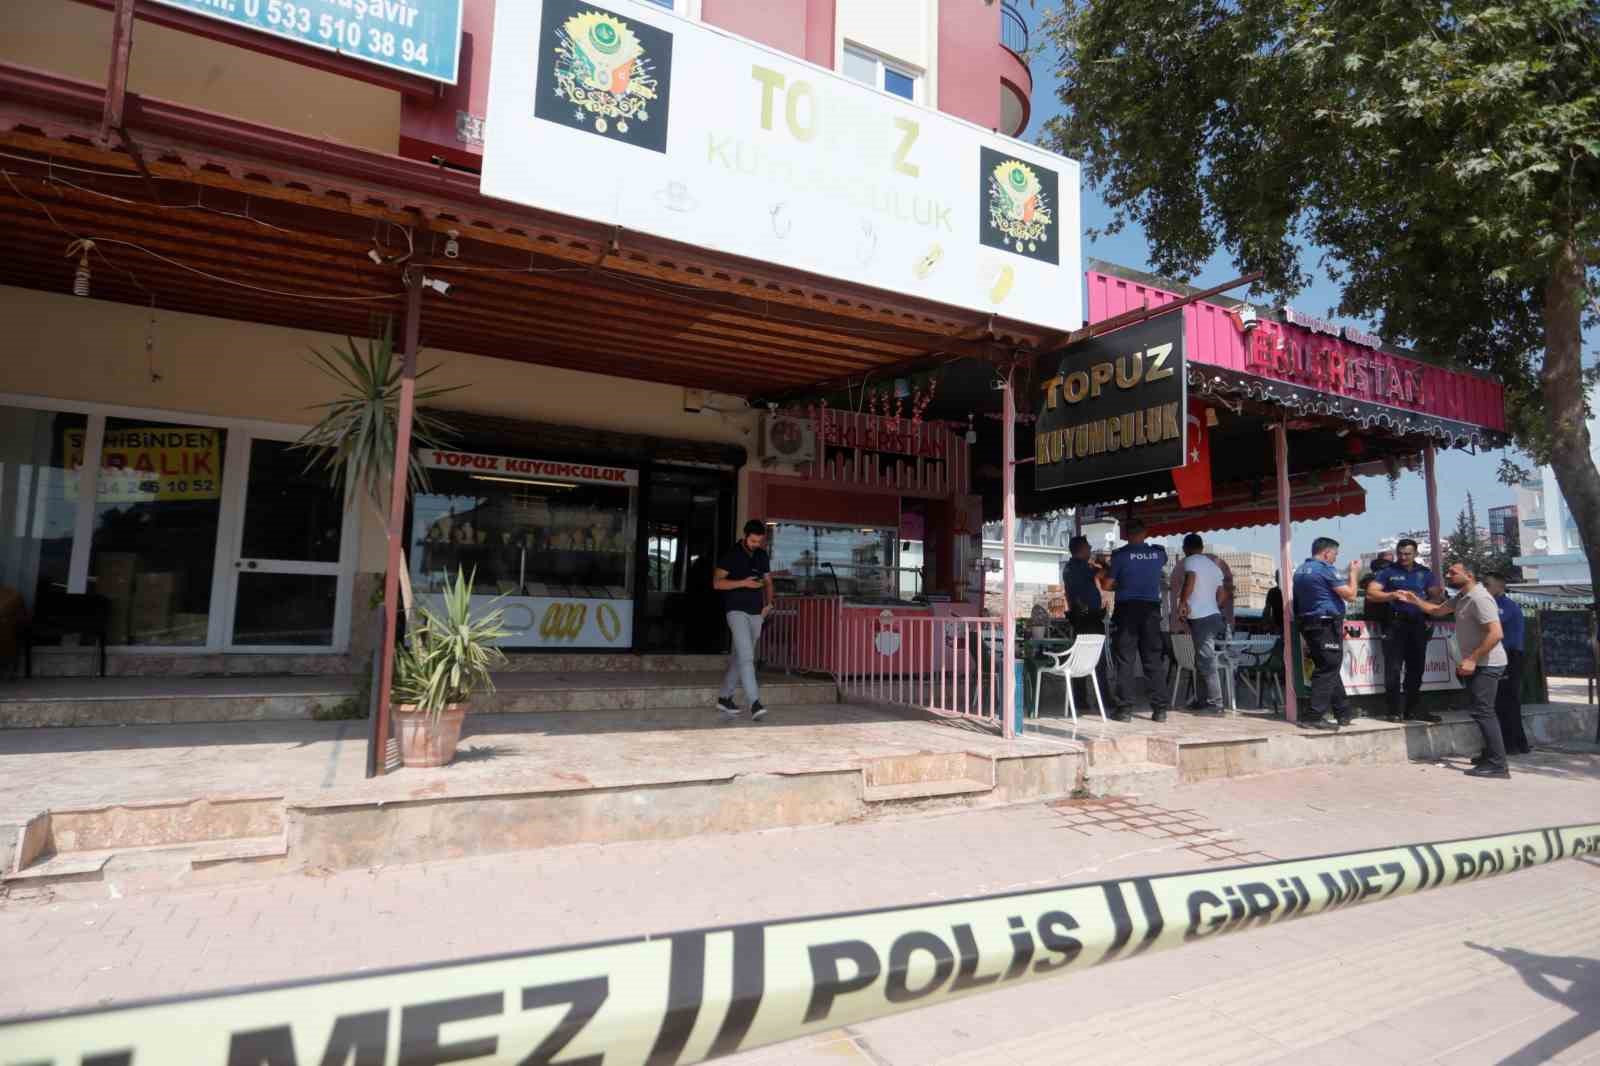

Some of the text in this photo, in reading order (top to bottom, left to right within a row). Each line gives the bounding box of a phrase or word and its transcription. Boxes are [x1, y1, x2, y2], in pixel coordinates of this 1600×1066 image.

[267, 0, 311, 33] 533
[320, 13, 361, 48] 510
[368, 27, 395, 56] 38
[401, 38, 429, 66] 94
[752, 64, 920, 178] TOZ
[1040, 342, 1175, 409] TOPUZ
[432, 450, 626, 482] TOPUZ KUYUMCULUK
[1035, 401, 1180, 465] KUYUMCULUK
